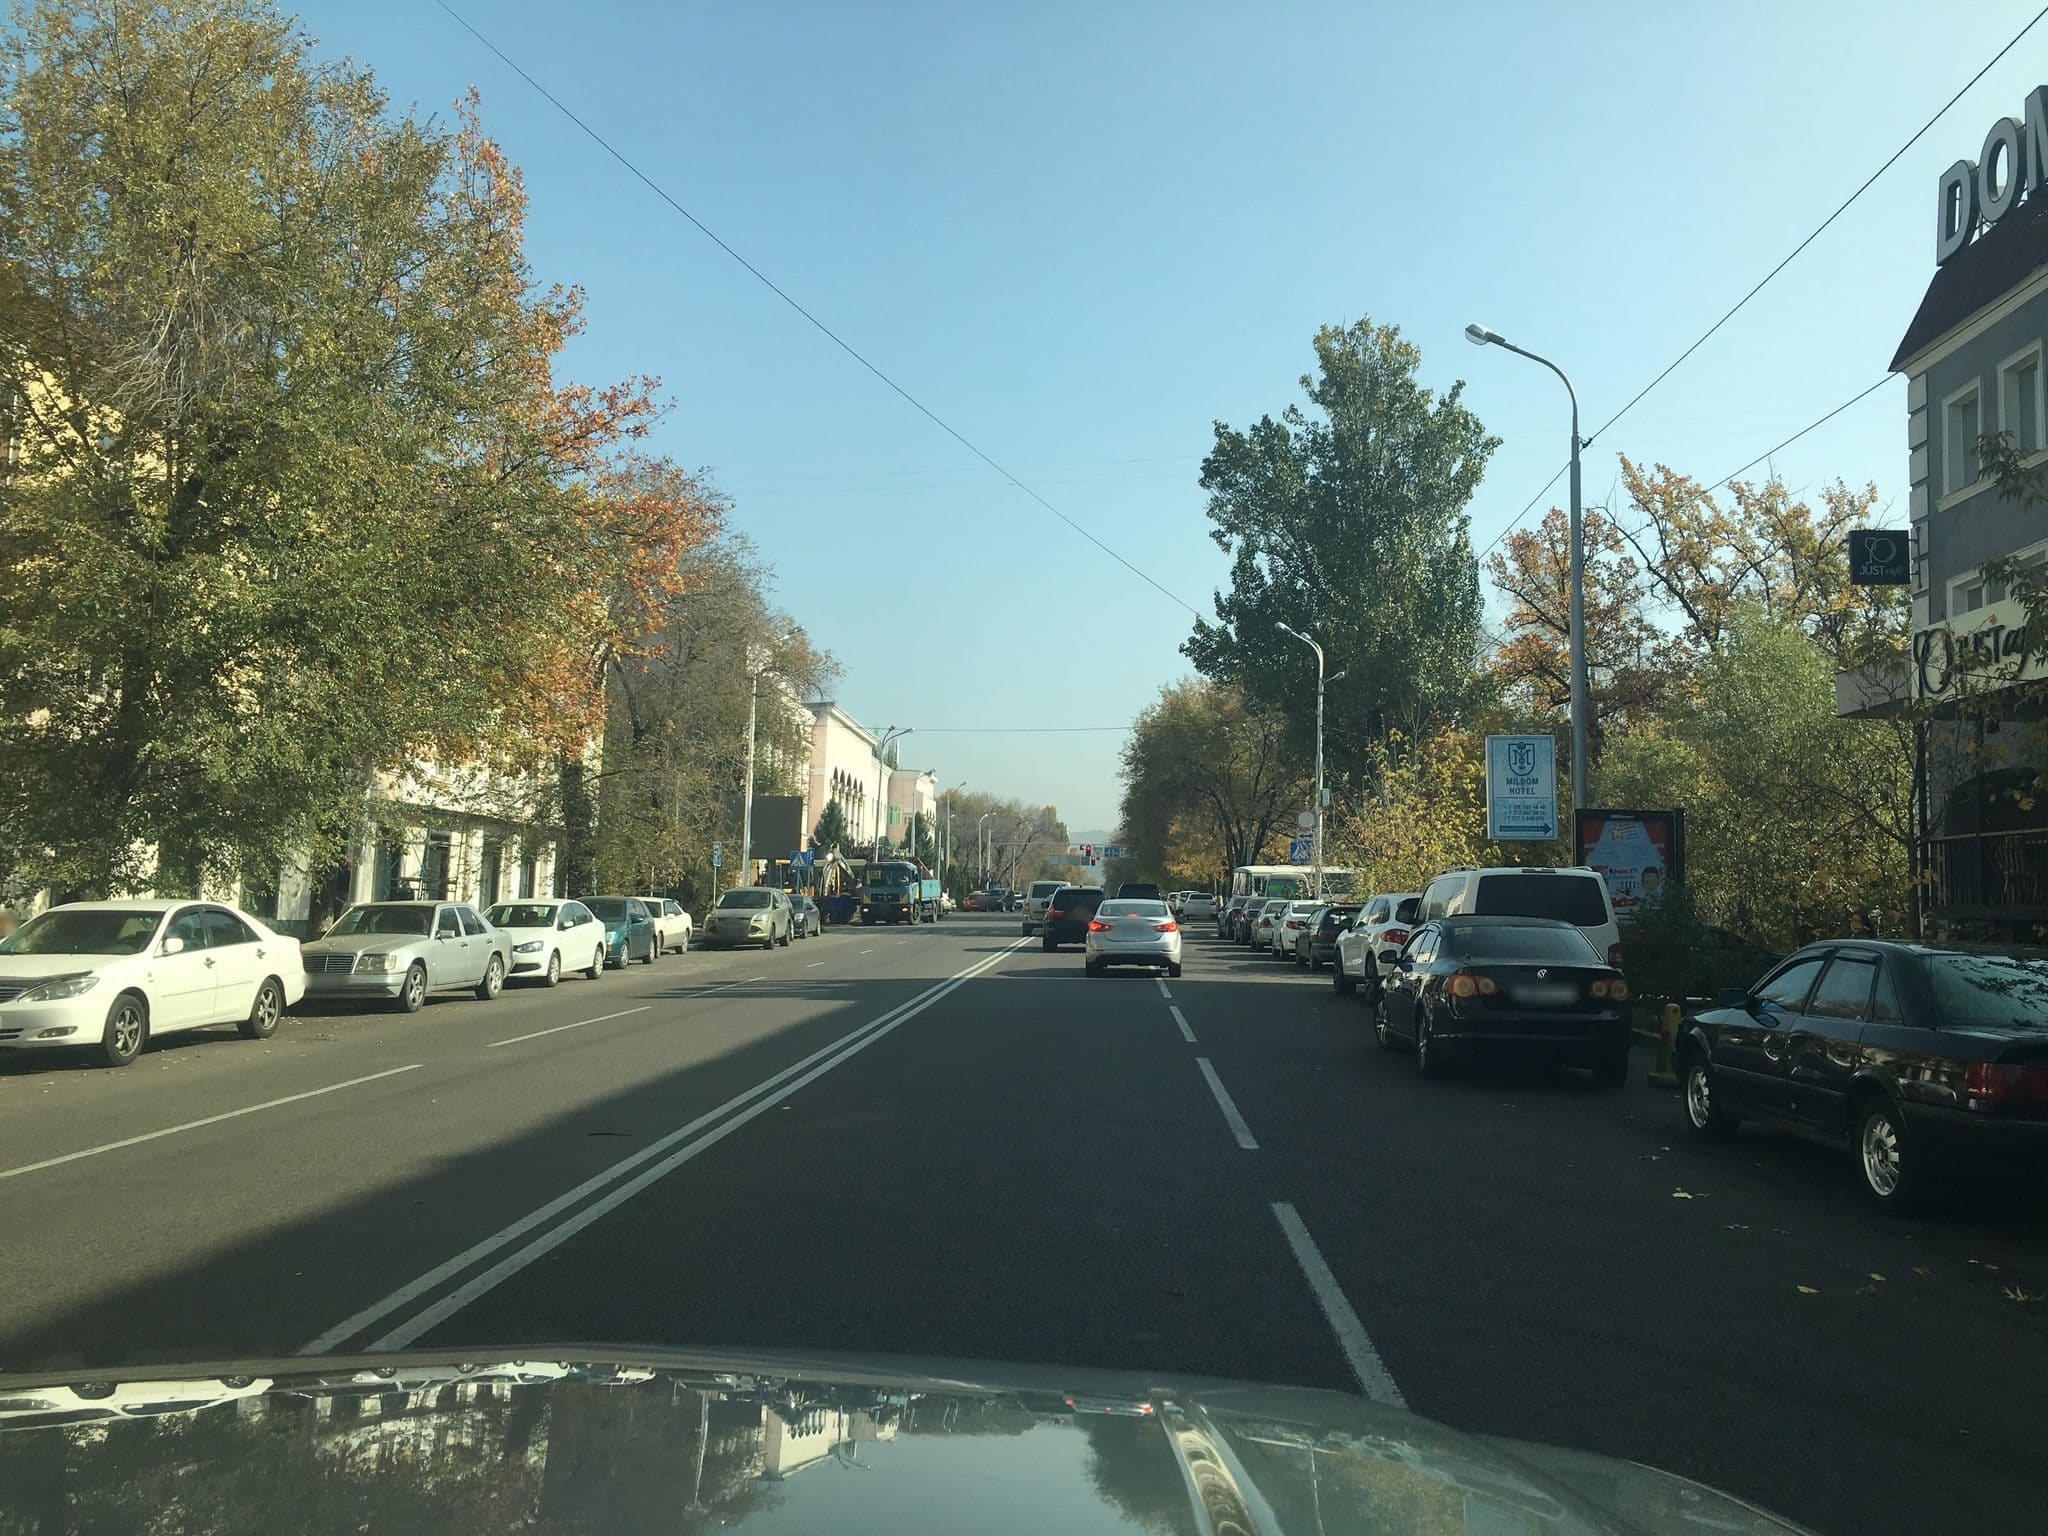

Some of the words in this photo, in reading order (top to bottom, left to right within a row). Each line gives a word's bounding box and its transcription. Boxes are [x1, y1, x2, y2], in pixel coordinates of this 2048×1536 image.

[1859, 565, 1885, 576] JUST
[1506, 777, 1539, 785] MILDOM
[1509, 787, 1536, 795] HOTEL
